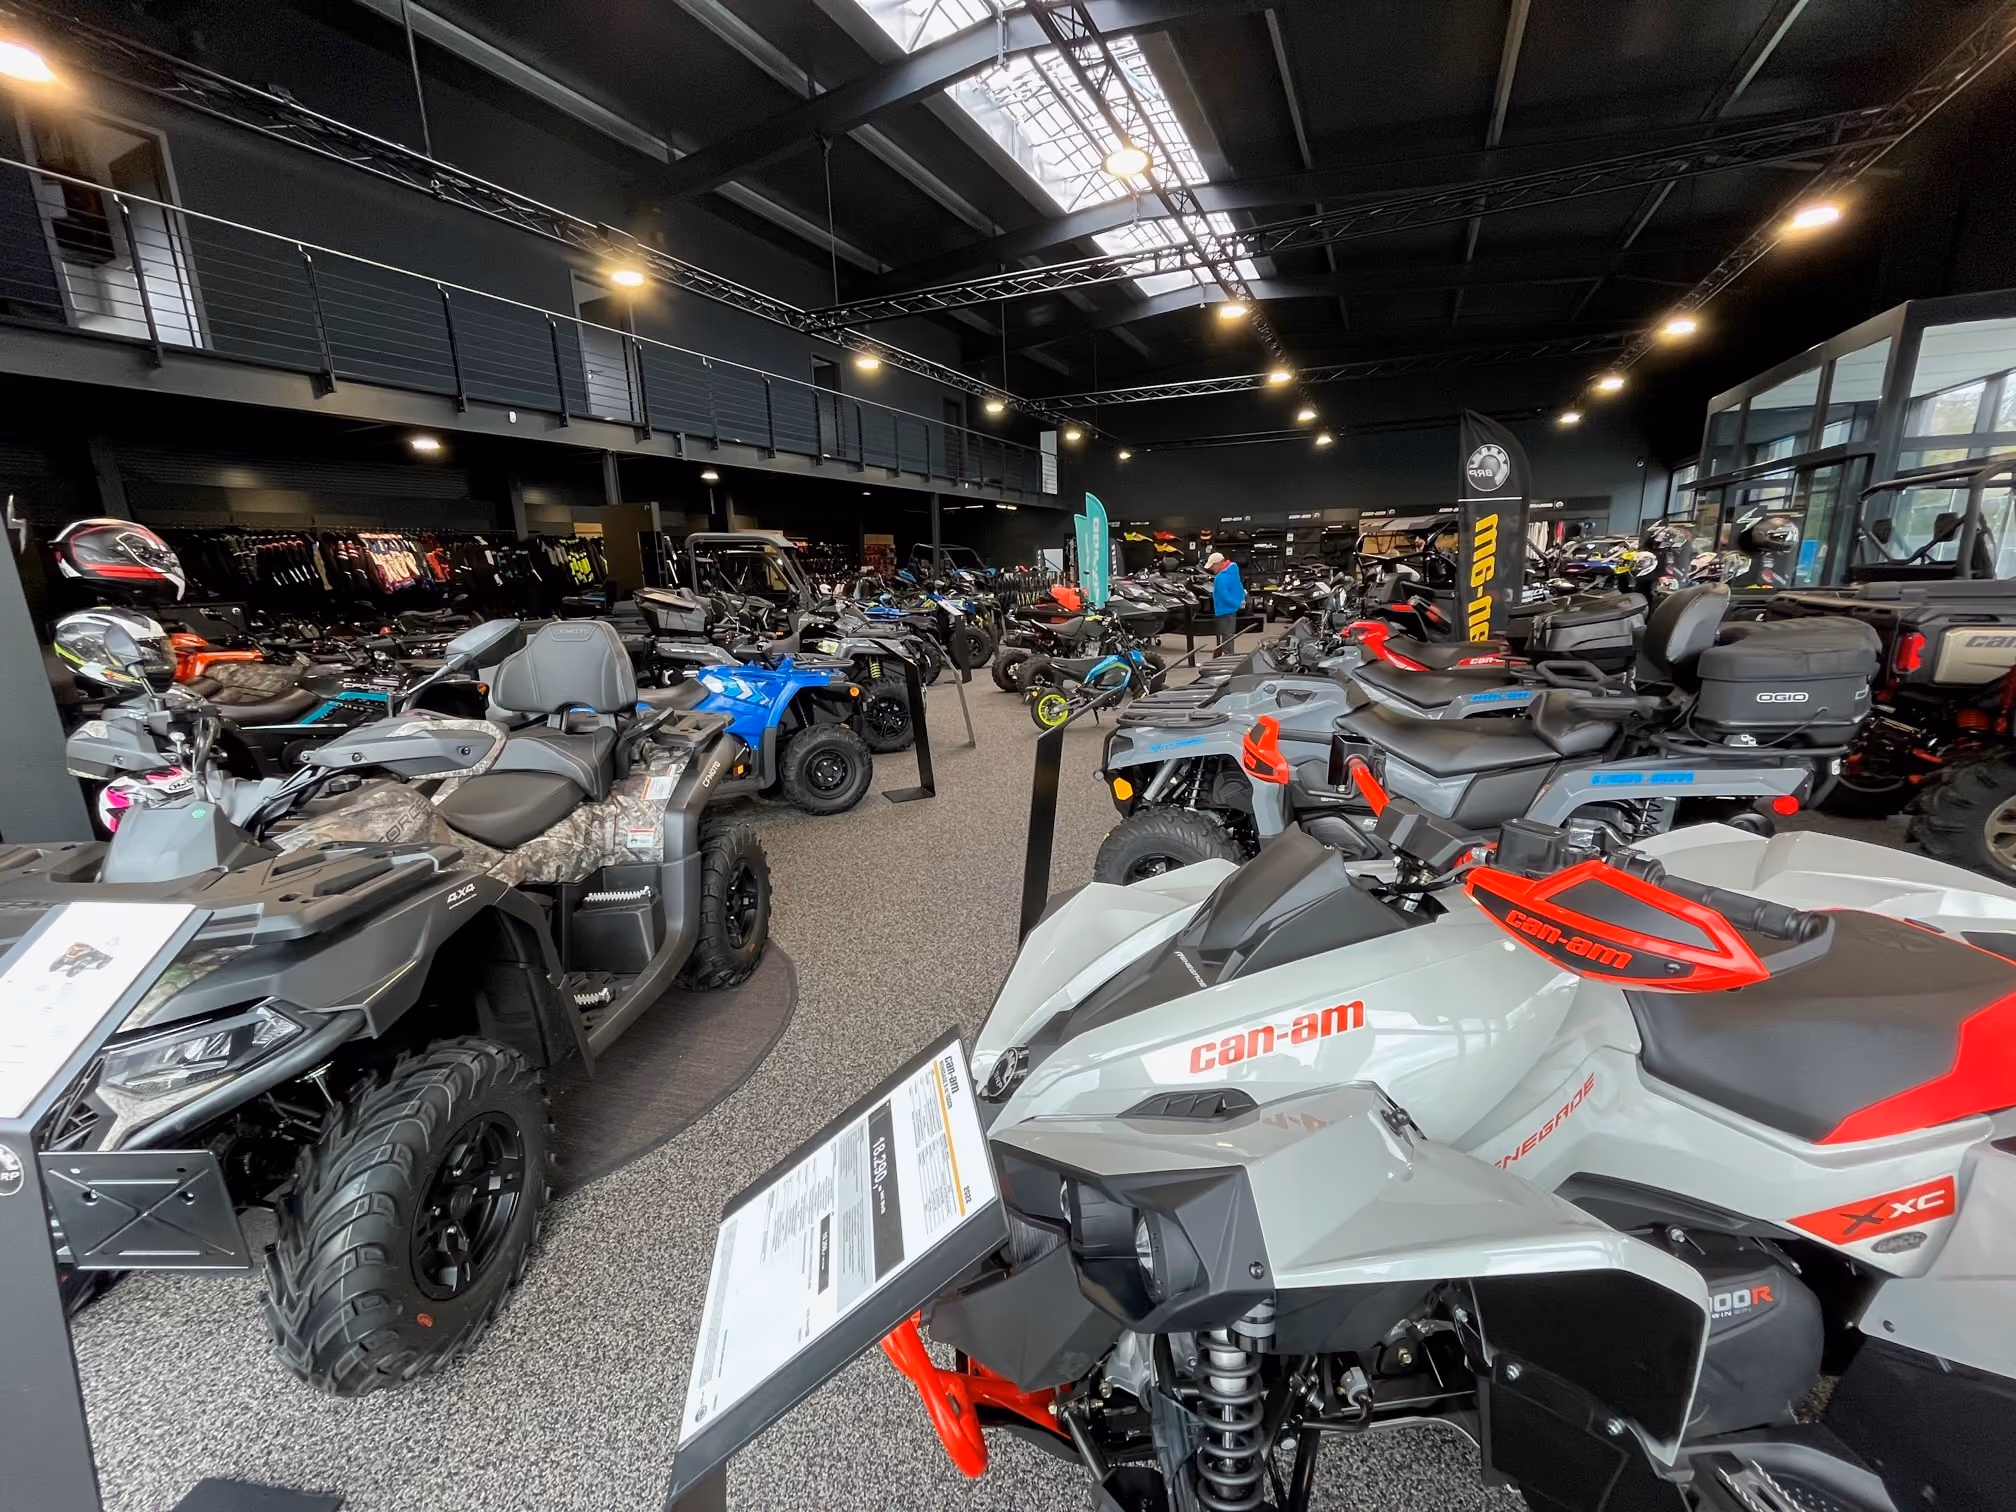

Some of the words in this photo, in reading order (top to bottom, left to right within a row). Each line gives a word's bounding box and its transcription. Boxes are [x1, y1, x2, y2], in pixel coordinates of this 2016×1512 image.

[1964, 636, 2016, 648] can
[1756, 692, 1809, 703] OGIO
[702, 761, 721, 788] CFMOTO
[378, 799, 432, 842] ORCE
[1505, 909, 1633, 970] can-am
[1189, 1000, 1365, 1074] can-am
[944, 1055, 960, 1094] can-am
[1494, 1072, 1595, 1170] NEGADE
[0, 1171, 20, 1181] RP
[963, 1185, 972, 1204] 2022
[1709, 1285, 1776, 1313] 00R
[1712, 1310, 1732, 1319] WIN
